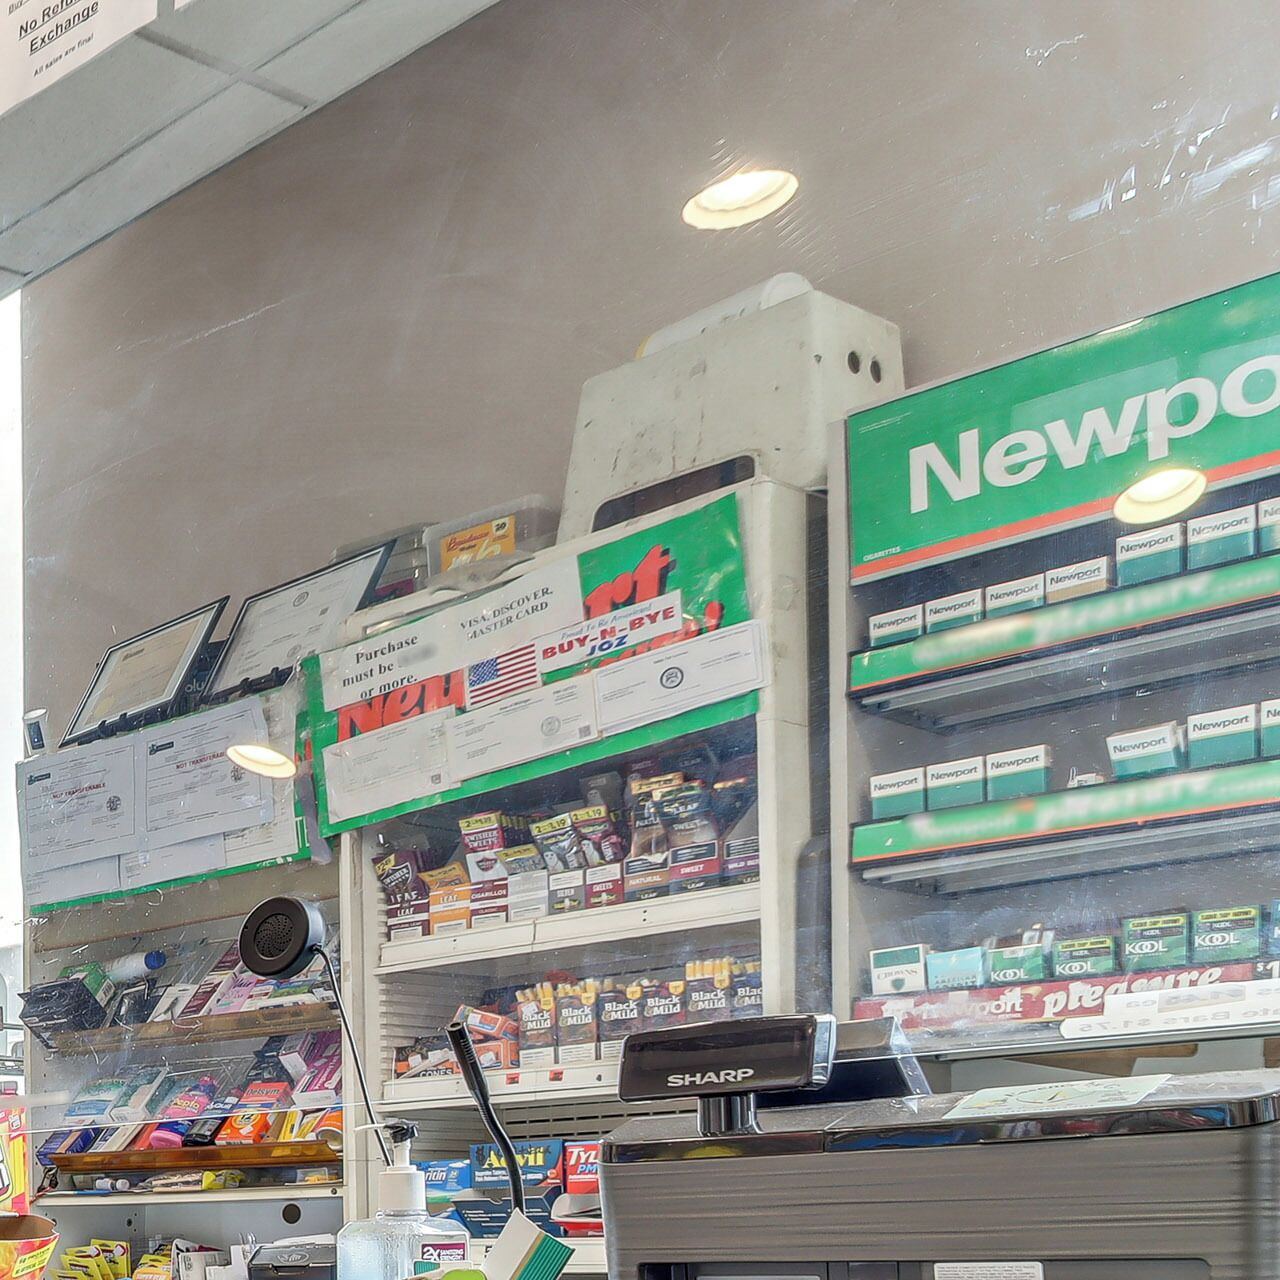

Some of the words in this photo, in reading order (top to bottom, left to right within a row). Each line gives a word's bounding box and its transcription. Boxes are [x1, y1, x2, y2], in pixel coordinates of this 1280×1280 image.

[28, 1, 100, 54] Exchange
[1118, 531, 1177, 556] Newport
[1048, 564, 1103, 587] Newport
[989, 582, 1040, 603] Newport
[459, 614, 490, 632] VISA,
[491, 586, 554, 621] DISCOVER,
[466, 615, 513, 641] MASTER
[514, 601, 550, 625] CARD
[541, 604, 677, 661] BUY-N-BYE
[354, 633, 419, 665] Purchase
[586, 633, 629, 658] JOZ
[341, 665, 372, 688] must
[373, 661, 395, 681] be
[359, 684, 377, 700] or
[378, 673, 419, 693] more.
[680, 863, 705, 875] SWEET
[471, 888, 507, 900] CIGARILLOS
[1055, 960, 1095, 977] KOOL
[1042, 964, 1225, 1020] pleasure
[561, 1005, 592, 1018] Black
[604, 999, 638, 1012] Black
[666, 1067, 755, 1088] SHARP
[245, 1086, 282, 1096] Delsym
